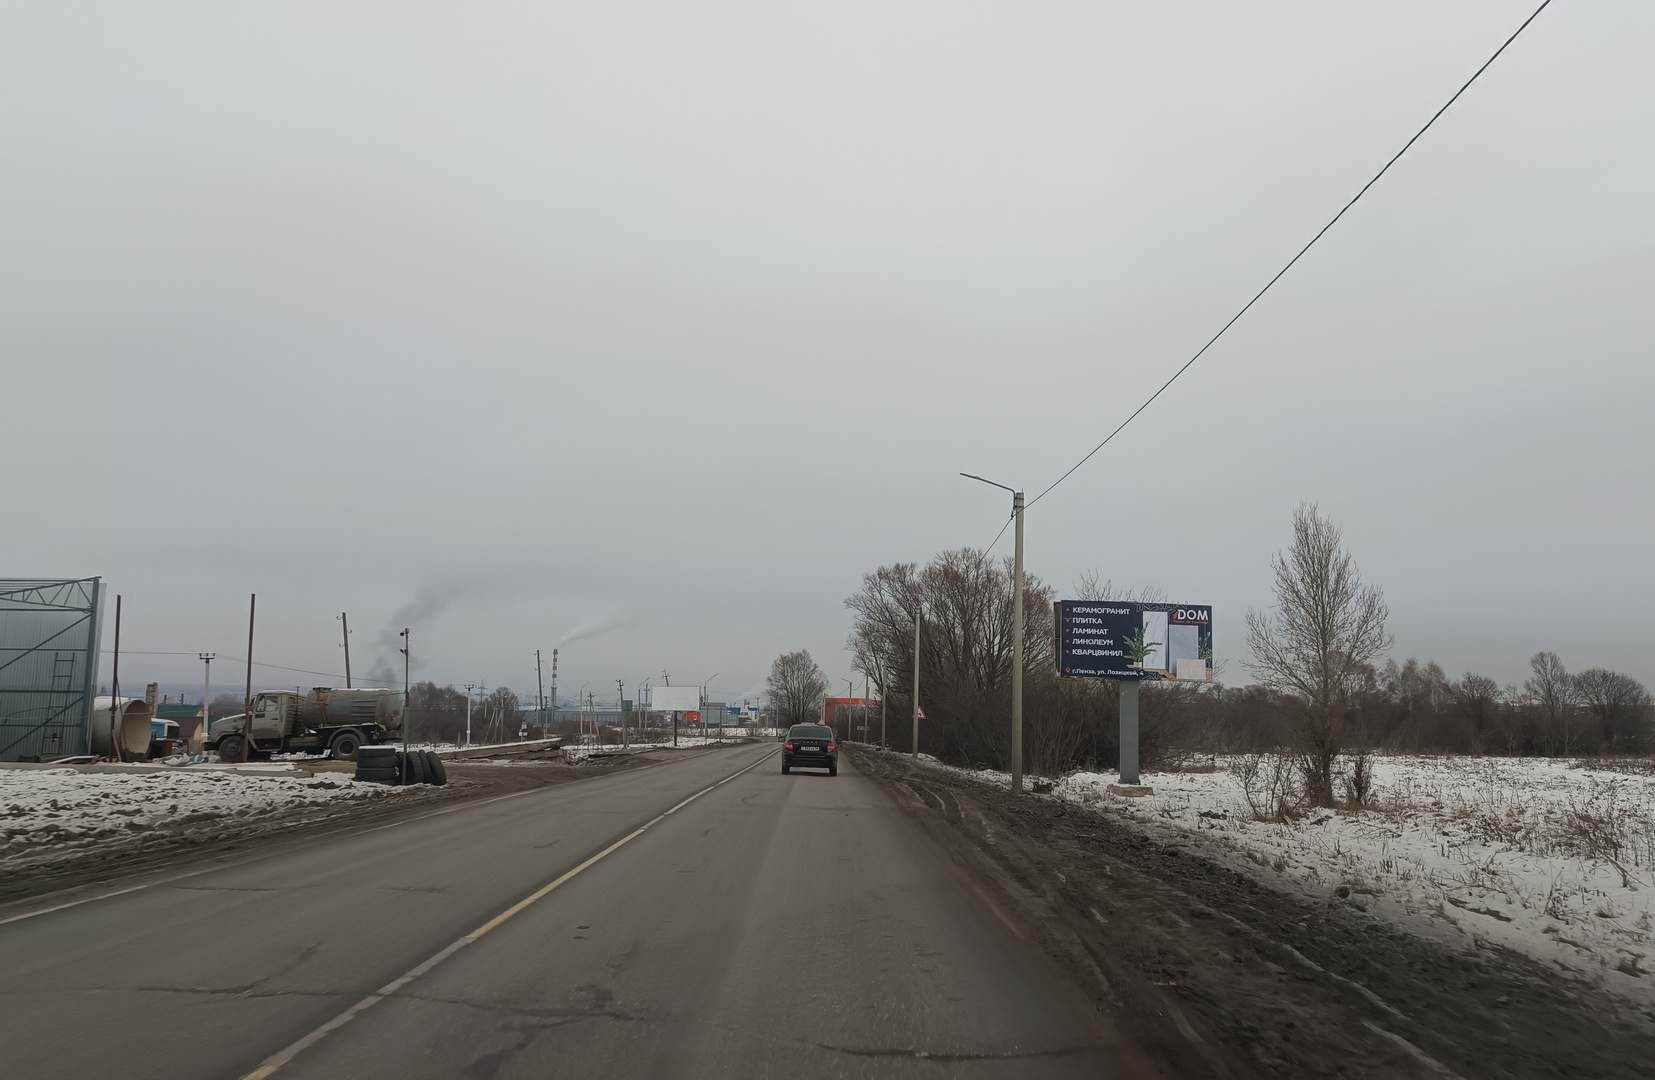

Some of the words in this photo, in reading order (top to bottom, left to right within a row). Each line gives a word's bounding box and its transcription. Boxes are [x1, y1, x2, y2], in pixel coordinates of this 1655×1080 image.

[1072, 606, 1131, 615] КЕРАМОГРАНИТ
[1072, 617, 1103, 625] ПЛИТКА
[1072, 627, 1109, 635] ЛАМИНАТ
[1072, 638, 1114, 646] ЛИНОЛЕУМ
[1072, 648, 1123, 657] КВАРЦВИНИЛ
